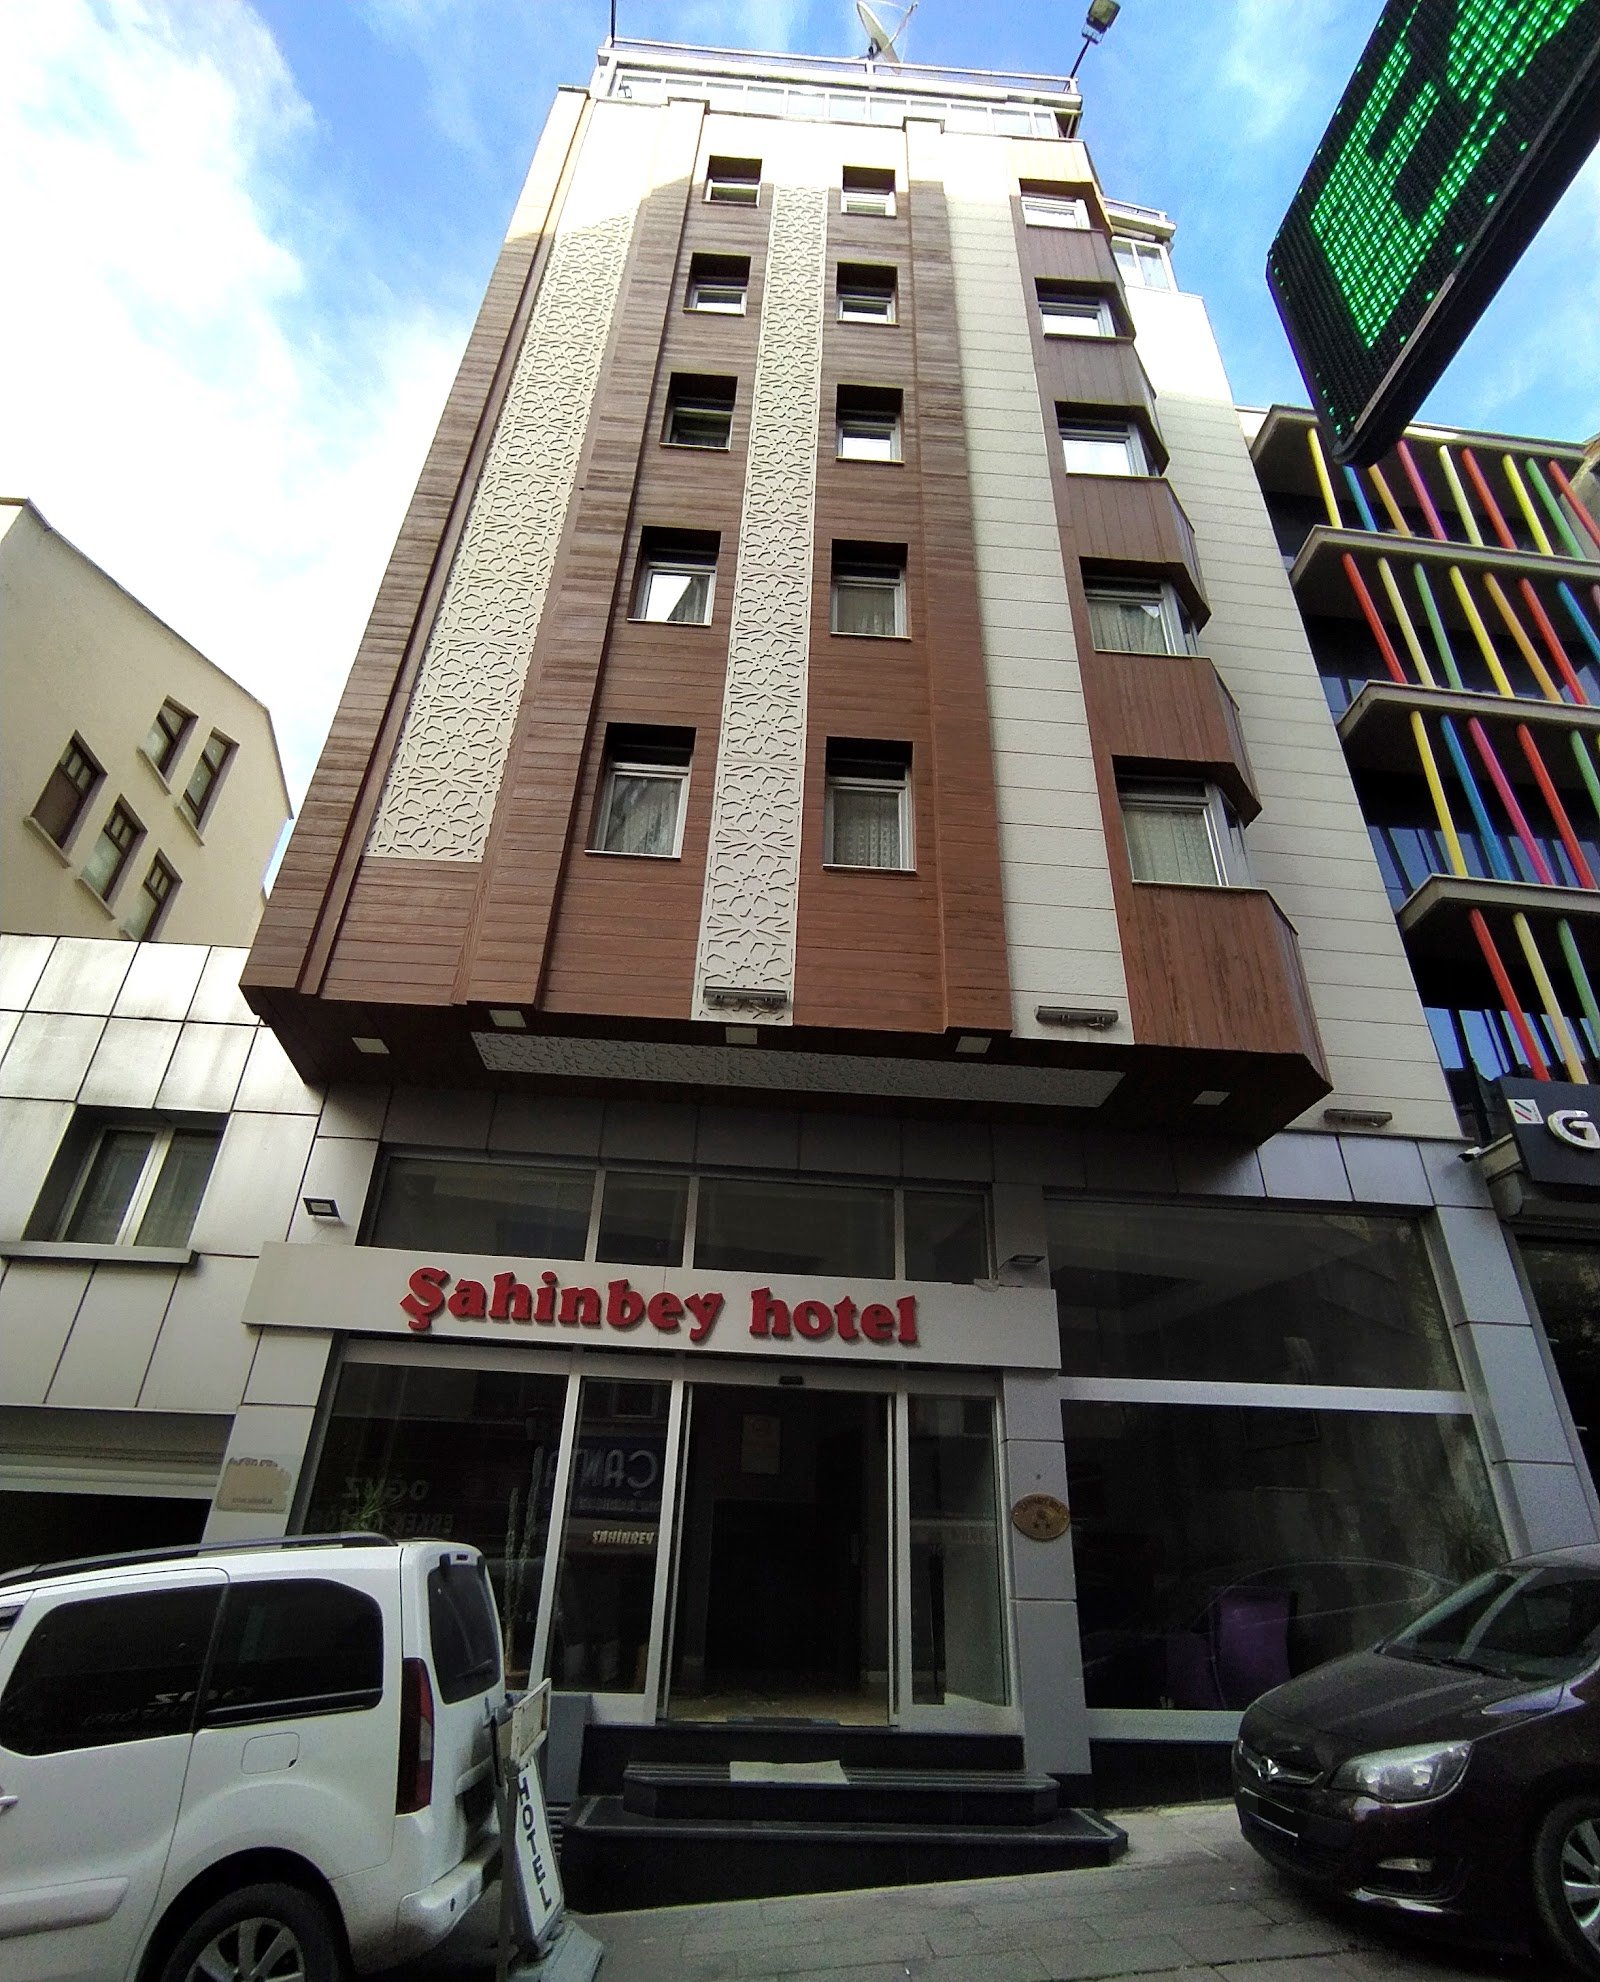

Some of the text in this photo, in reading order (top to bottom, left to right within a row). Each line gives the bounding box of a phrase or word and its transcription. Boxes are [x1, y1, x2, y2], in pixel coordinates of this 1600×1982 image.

[400, 1267, 917, 1343] Şahinbey hotel
[518, 1776, 552, 1912] HOTEL
